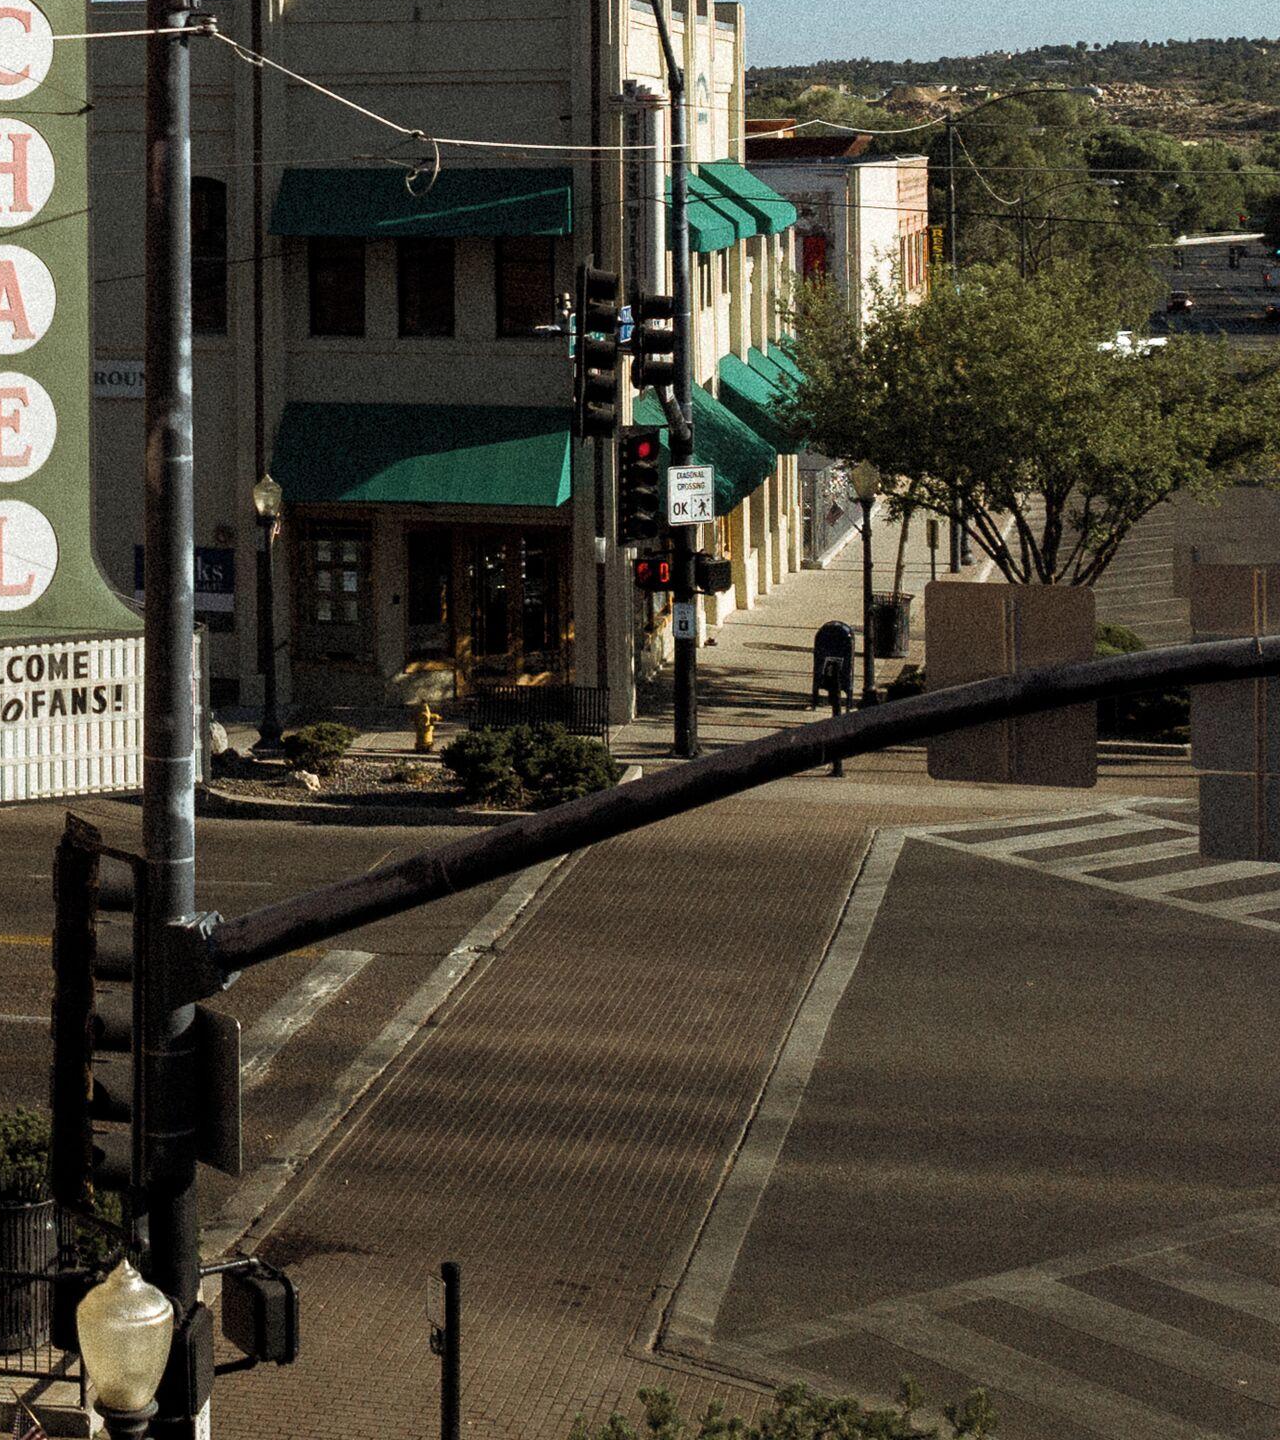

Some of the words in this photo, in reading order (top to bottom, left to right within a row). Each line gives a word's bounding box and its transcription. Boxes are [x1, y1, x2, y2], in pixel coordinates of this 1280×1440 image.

[676, 470, 705, 479] DIAGONAL
[677, 482, 706, 491] CROSSING
[673, 501, 689, 516] OK
[31, 683, 125, 719] FANS!
